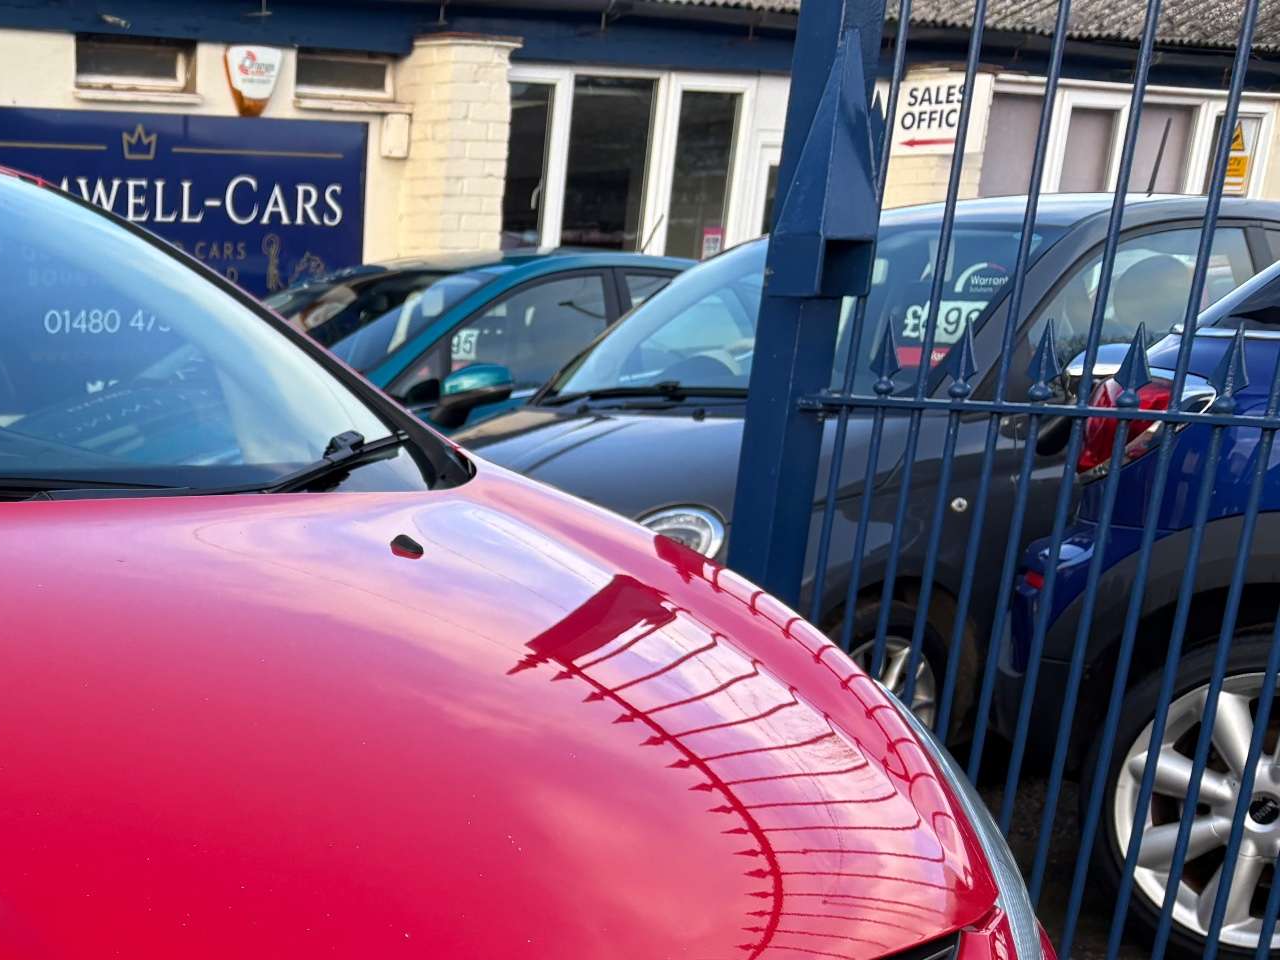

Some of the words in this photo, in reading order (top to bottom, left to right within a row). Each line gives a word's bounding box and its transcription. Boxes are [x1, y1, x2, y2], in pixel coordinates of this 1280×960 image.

[907, 85, 965, 107] SALES
[901, 109, 959, 130] OFFIC
[194, 241, 248, 260] CARS
[970, 275, 1009, 286] Warrant
[43, 309, 121, 335] 01480
